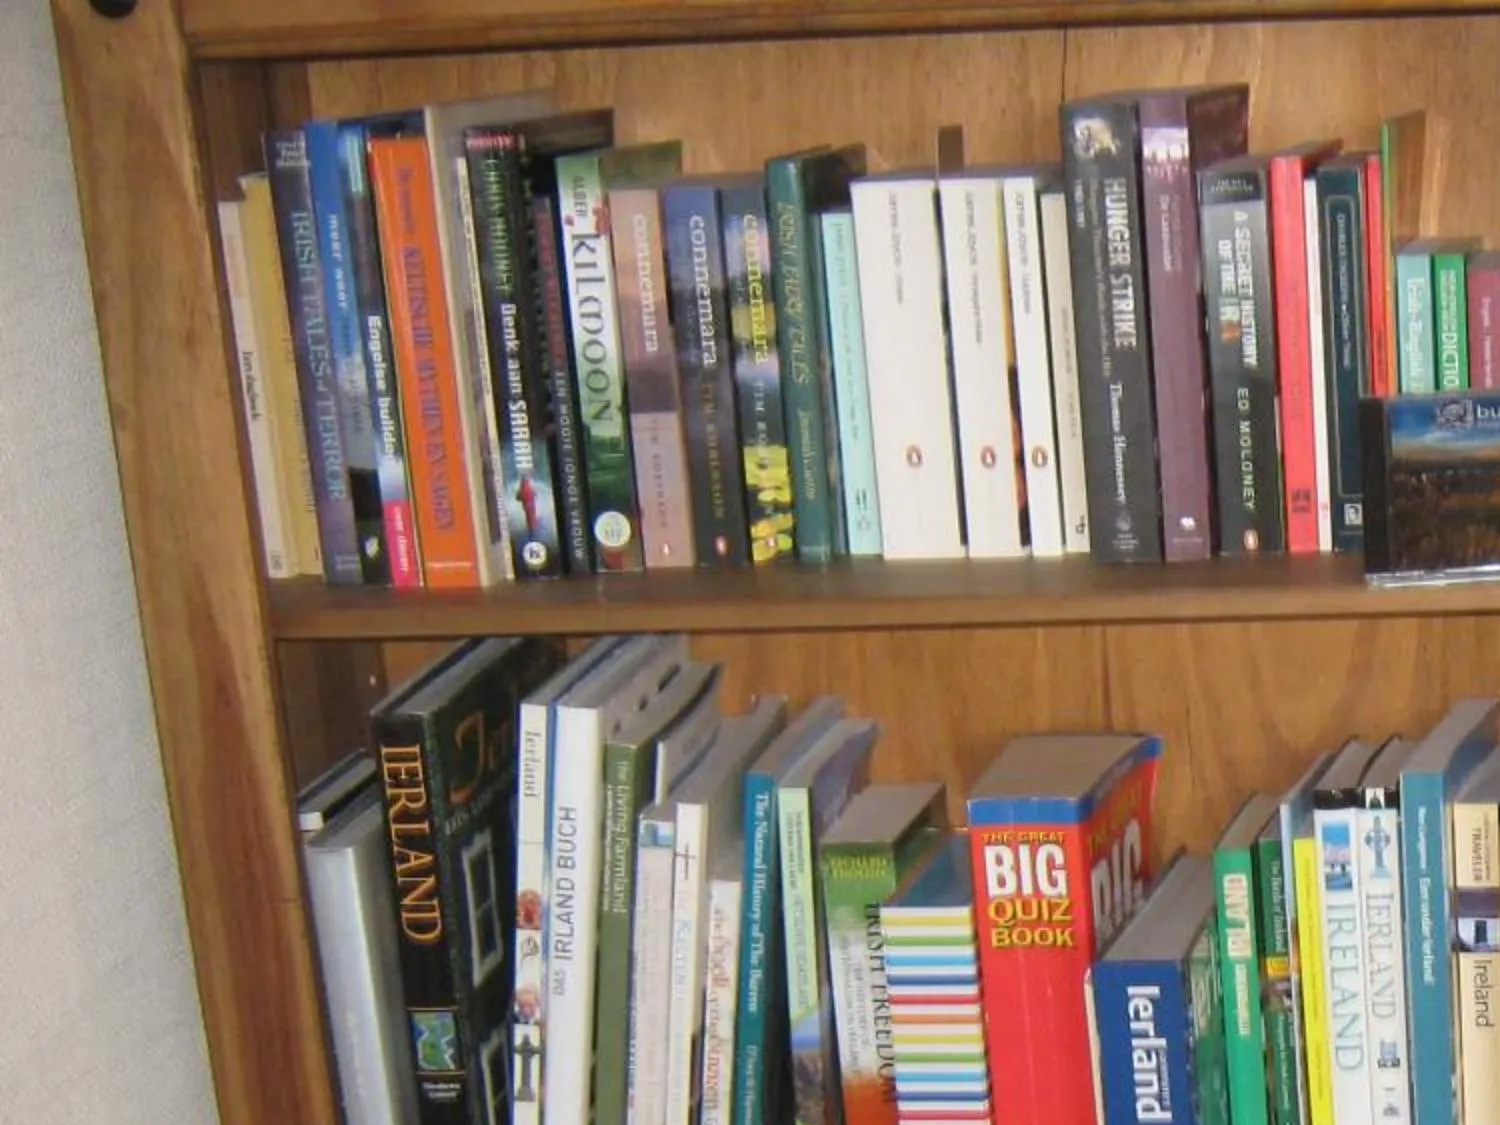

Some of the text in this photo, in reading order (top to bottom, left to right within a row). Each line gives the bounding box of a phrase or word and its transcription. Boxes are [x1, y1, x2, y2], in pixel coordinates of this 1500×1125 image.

[290, 212, 317, 283] IRISH
[402, 247, 435, 350] KELTISCHE
[632, 213, 662, 354] connemara
[688, 213, 720, 368] connemara
[742, 213, 773, 366] connemara
[1104, 178, 1138, 351] HUNGER STRIKE
[1217, 239, 1235, 261] OF
[1220, 263, 1238, 296] THE
[1233, 210, 1258, 367] A SECRET HISTORY
[304, 293, 332, 377] TALES
[500, 303, 535, 469] Denk aan SARAH
[317, 394, 347, 501] TERROR
[1109, 383, 1125, 434] Thomas
[1236, 388, 1257, 512] ED MOLONEY
[522, 729, 543, 799] Ierland
[380, 743, 443, 945] IERLAND
[555, 805, 578, 871] BUCH
[611, 760, 631, 914] the Living Farmland
[982, 830, 1066, 844] THE GREAT
[984, 844, 1068, 898] BIG
[1471, 827, 1484, 882] TRAVELER
[552, 876, 576, 962] IRLAND
[748, 792, 769, 1013] The Natural History of The Burren
[988, 898, 1073, 926] QUIZ
[990, 927, 1073, 949] BOOK
[1224, 873, 1253, 960] IRLAND
[863, 903, 897, 1104] IRISH FREEDOM
[1327, 904, 1365, 1071] IRELAND
[1365, 892, 1397, 1020] IERLAND
[1473, 959, 1496, 1027] Ireland
[1126, 985, 1173, 1124] Ierland
